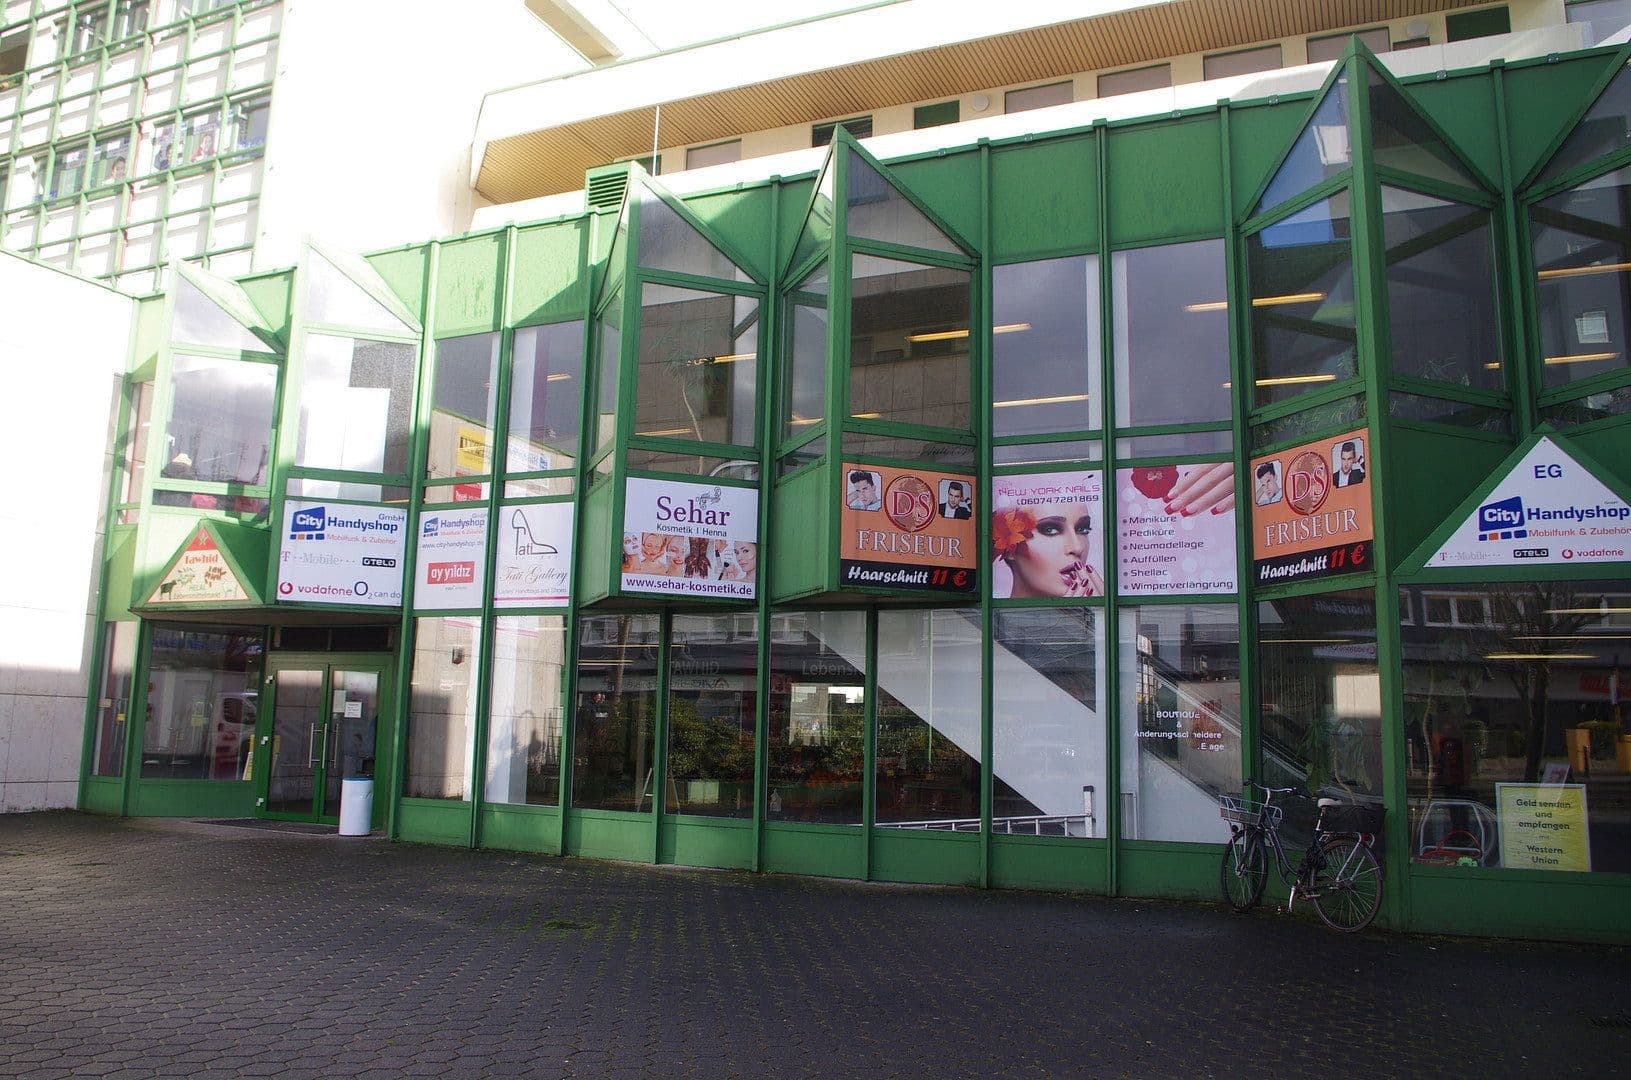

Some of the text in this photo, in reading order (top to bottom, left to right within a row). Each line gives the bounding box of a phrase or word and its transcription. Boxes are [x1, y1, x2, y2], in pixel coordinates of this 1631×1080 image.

[1534, 464, 1562, 479] EG
[1290, 466, 1326, 502] DS
[656, 496, 730, 526] Sehar
[891, 490, 931, 520] DS
[1484, 505, 1630, 525] City Handyshop
[296, 514, 398, 533] City Handyshop
[441, 518, 485, 529] Handyshop
[656, 523, 693, 534] Kosmetik
[702, 528, 727, 537] Henna
[1264, 508, 1359, 547] FRISEUR
[1528, 527, 1575, 538] Mobilfunk
[1579, 527, 1587, 536] &
[857, 529, 964, 558] FRISEUR
[1129, 540, 1204, 550] Neumodellage
[1577, 548, 1624, 558] vodafone
[525, 564, 568, 584] Gallery
[1130, 568, 1169, 577] Shellac
[1260, 555, 1327, 579] Haarschnitt
[848, 566, 928, 584] Haarschnitt
[298, 584, 352, 596] vodafone
[626, 578, 752, 596] www.sehar-kosmetik.de
[1516, 799, 1571, 809] Geld senden
[1518, 821, 1570, 831] empfangen
[1526, 844, 1563, 854] Western
[1532, 856, 1559, 865] Union
